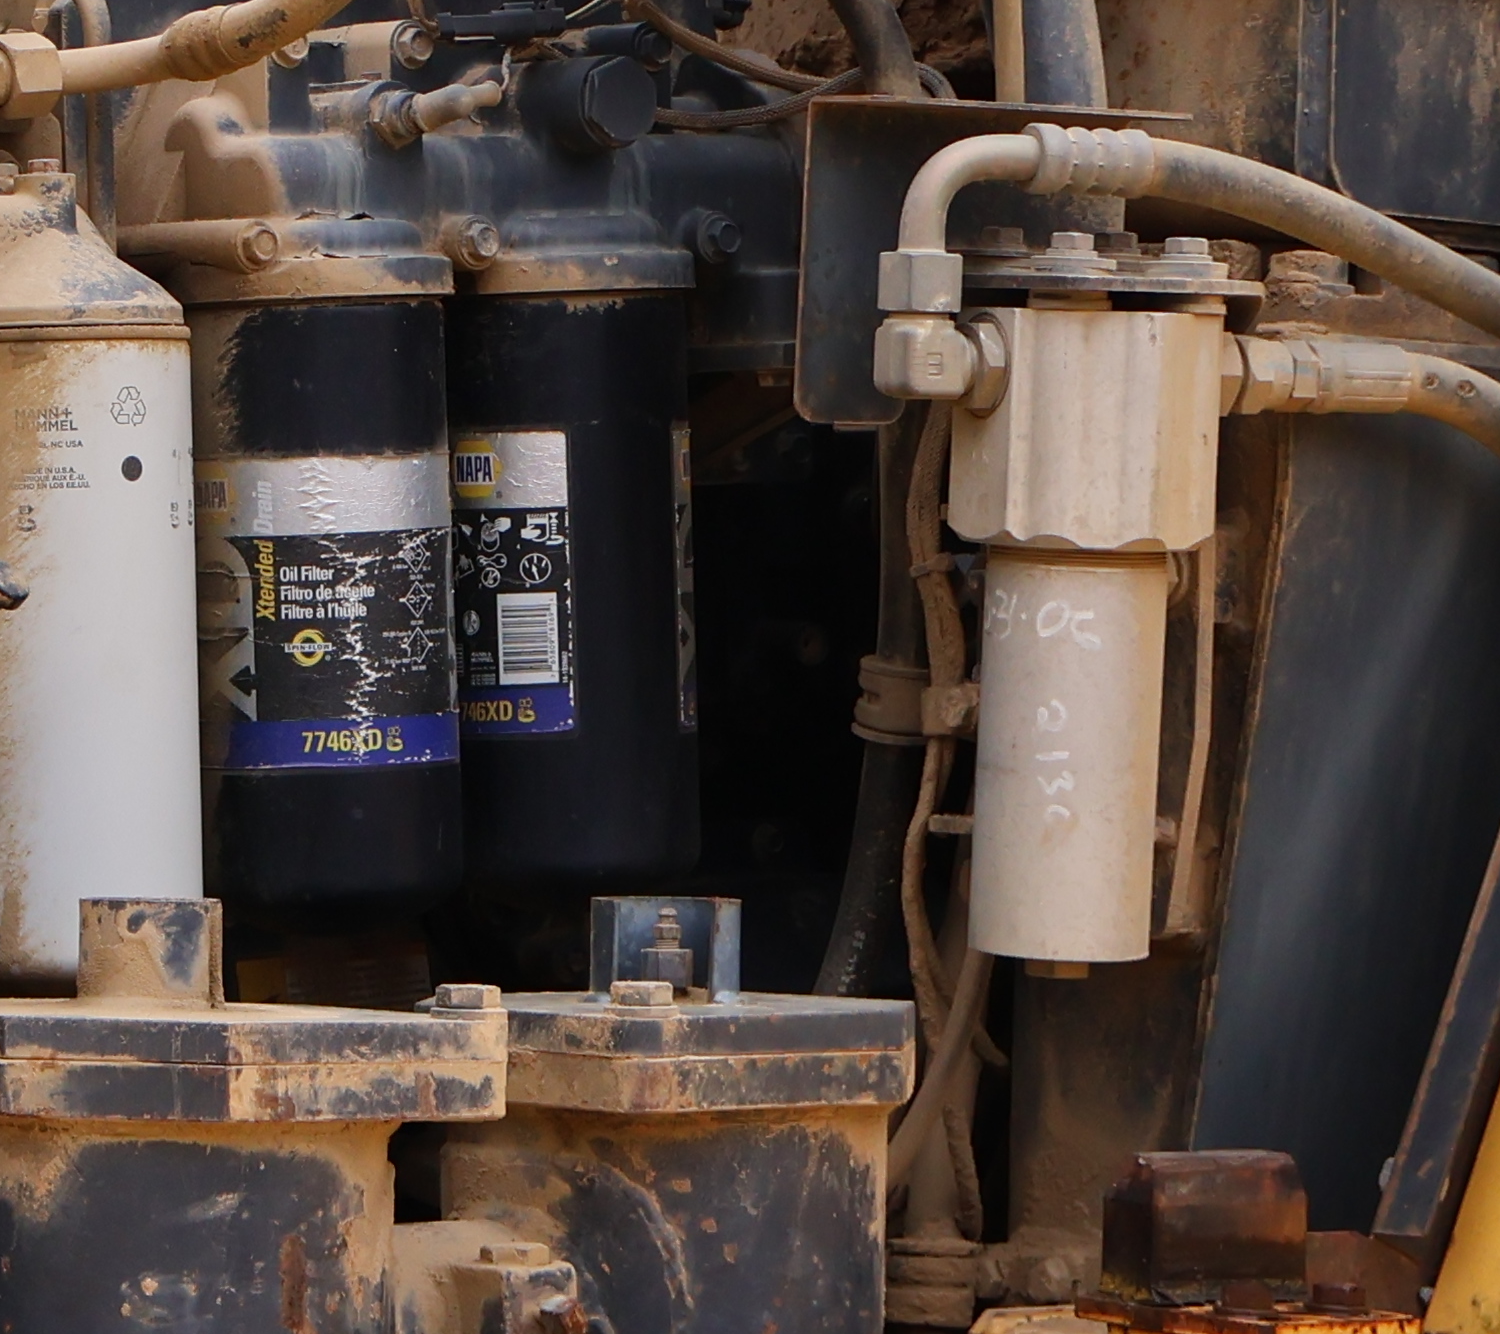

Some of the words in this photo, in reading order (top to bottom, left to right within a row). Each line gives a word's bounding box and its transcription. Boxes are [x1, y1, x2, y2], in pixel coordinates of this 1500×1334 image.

[65, 440, 84, 448] USA
[456, 456, 492, 482] NAPA
[253, 481, 274, 534] Drain
[256, 540, 275, 621] Xtended
[279, 565, 299, 583] Oil
[301, 565, 335, 582] Filter
[280, 584, 313, 602] Filtro
[316, 584, 332, 600] de
[334, 583, 376, 599] aceite
[281, 602, 314, 620] Filtre
[316, 602, 325, 619] à
[286, 643, 330, 652] SPIN-FLOW
[301, 727, 383, 753] 7746XD
